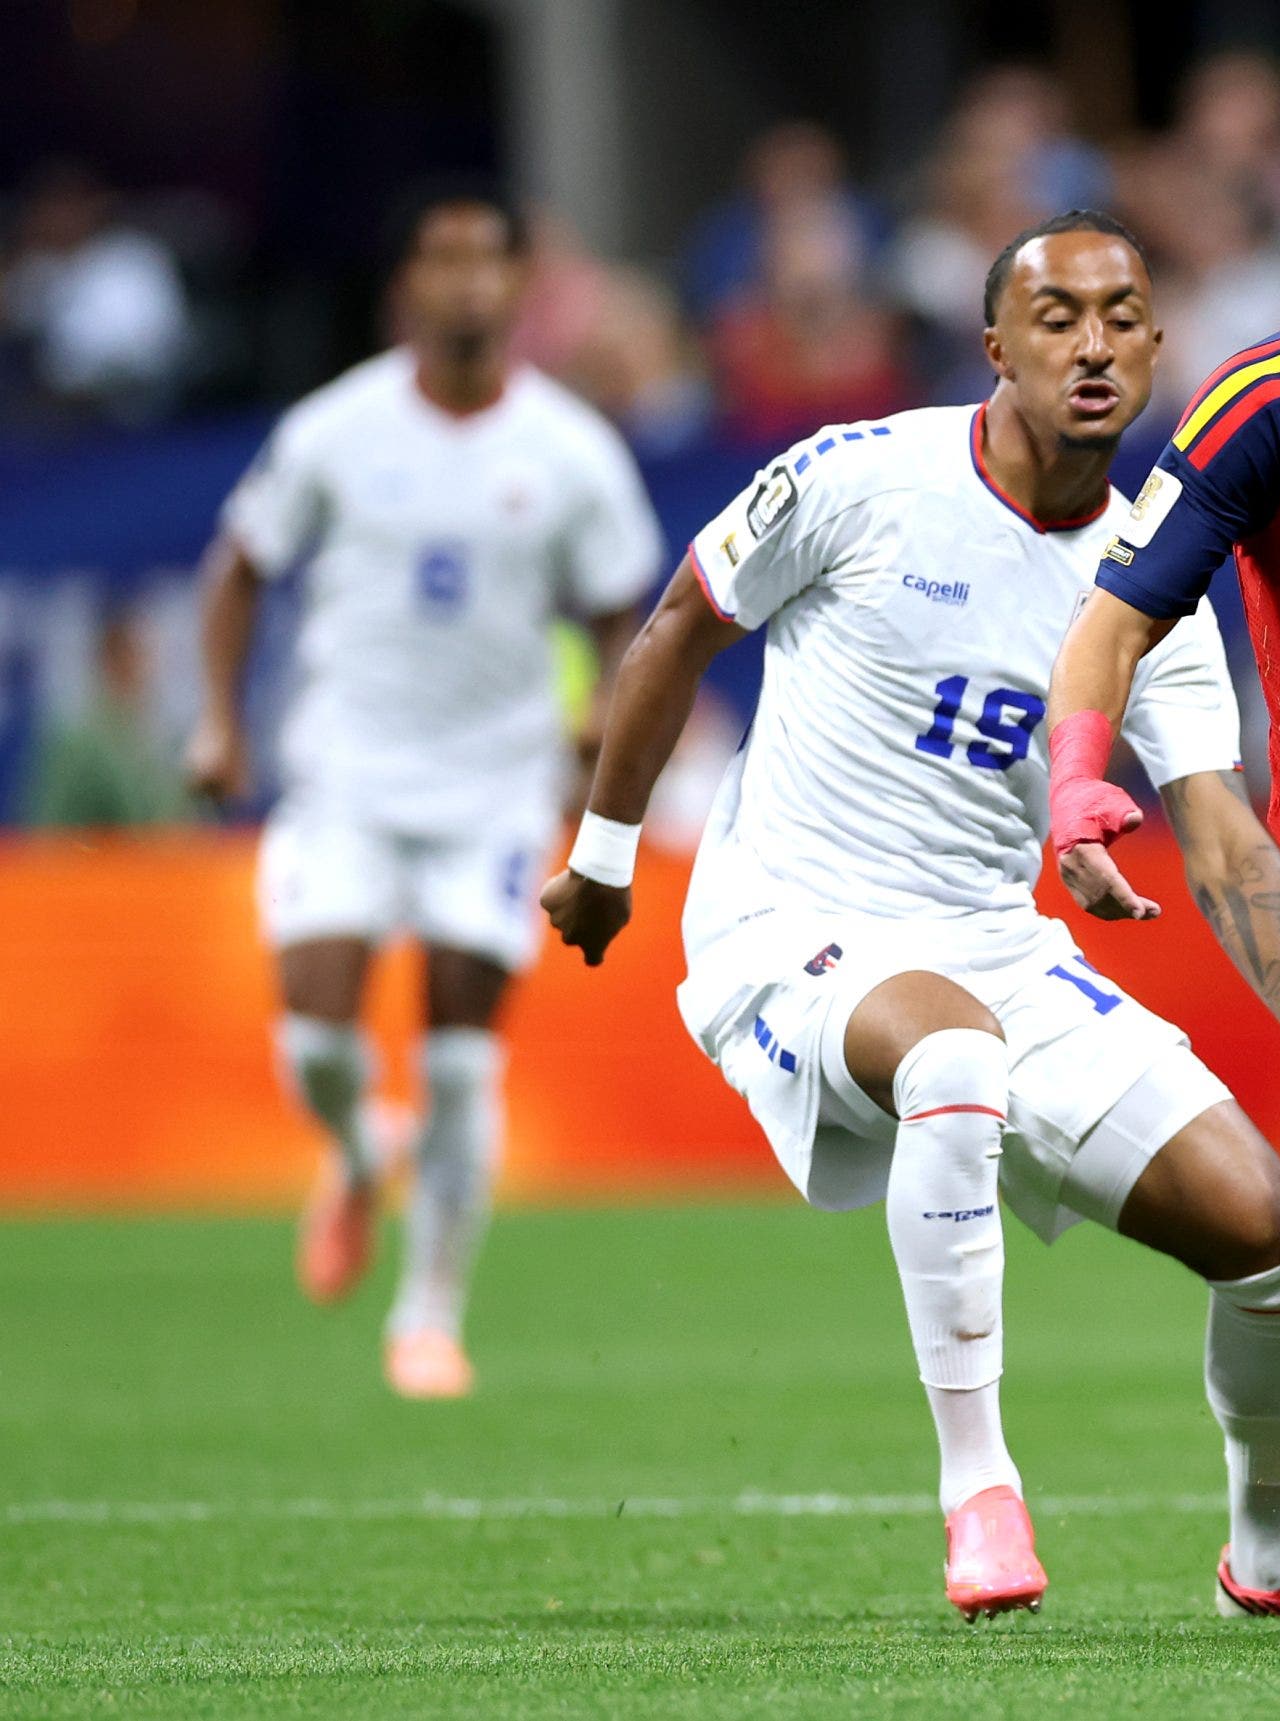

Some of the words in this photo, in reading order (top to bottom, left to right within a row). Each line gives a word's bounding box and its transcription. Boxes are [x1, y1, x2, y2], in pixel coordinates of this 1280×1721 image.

[902, 574, 970, 601] capelli
[915, 674, 1046, 771] 19
[1044, 954, 1124, 1016] 1
